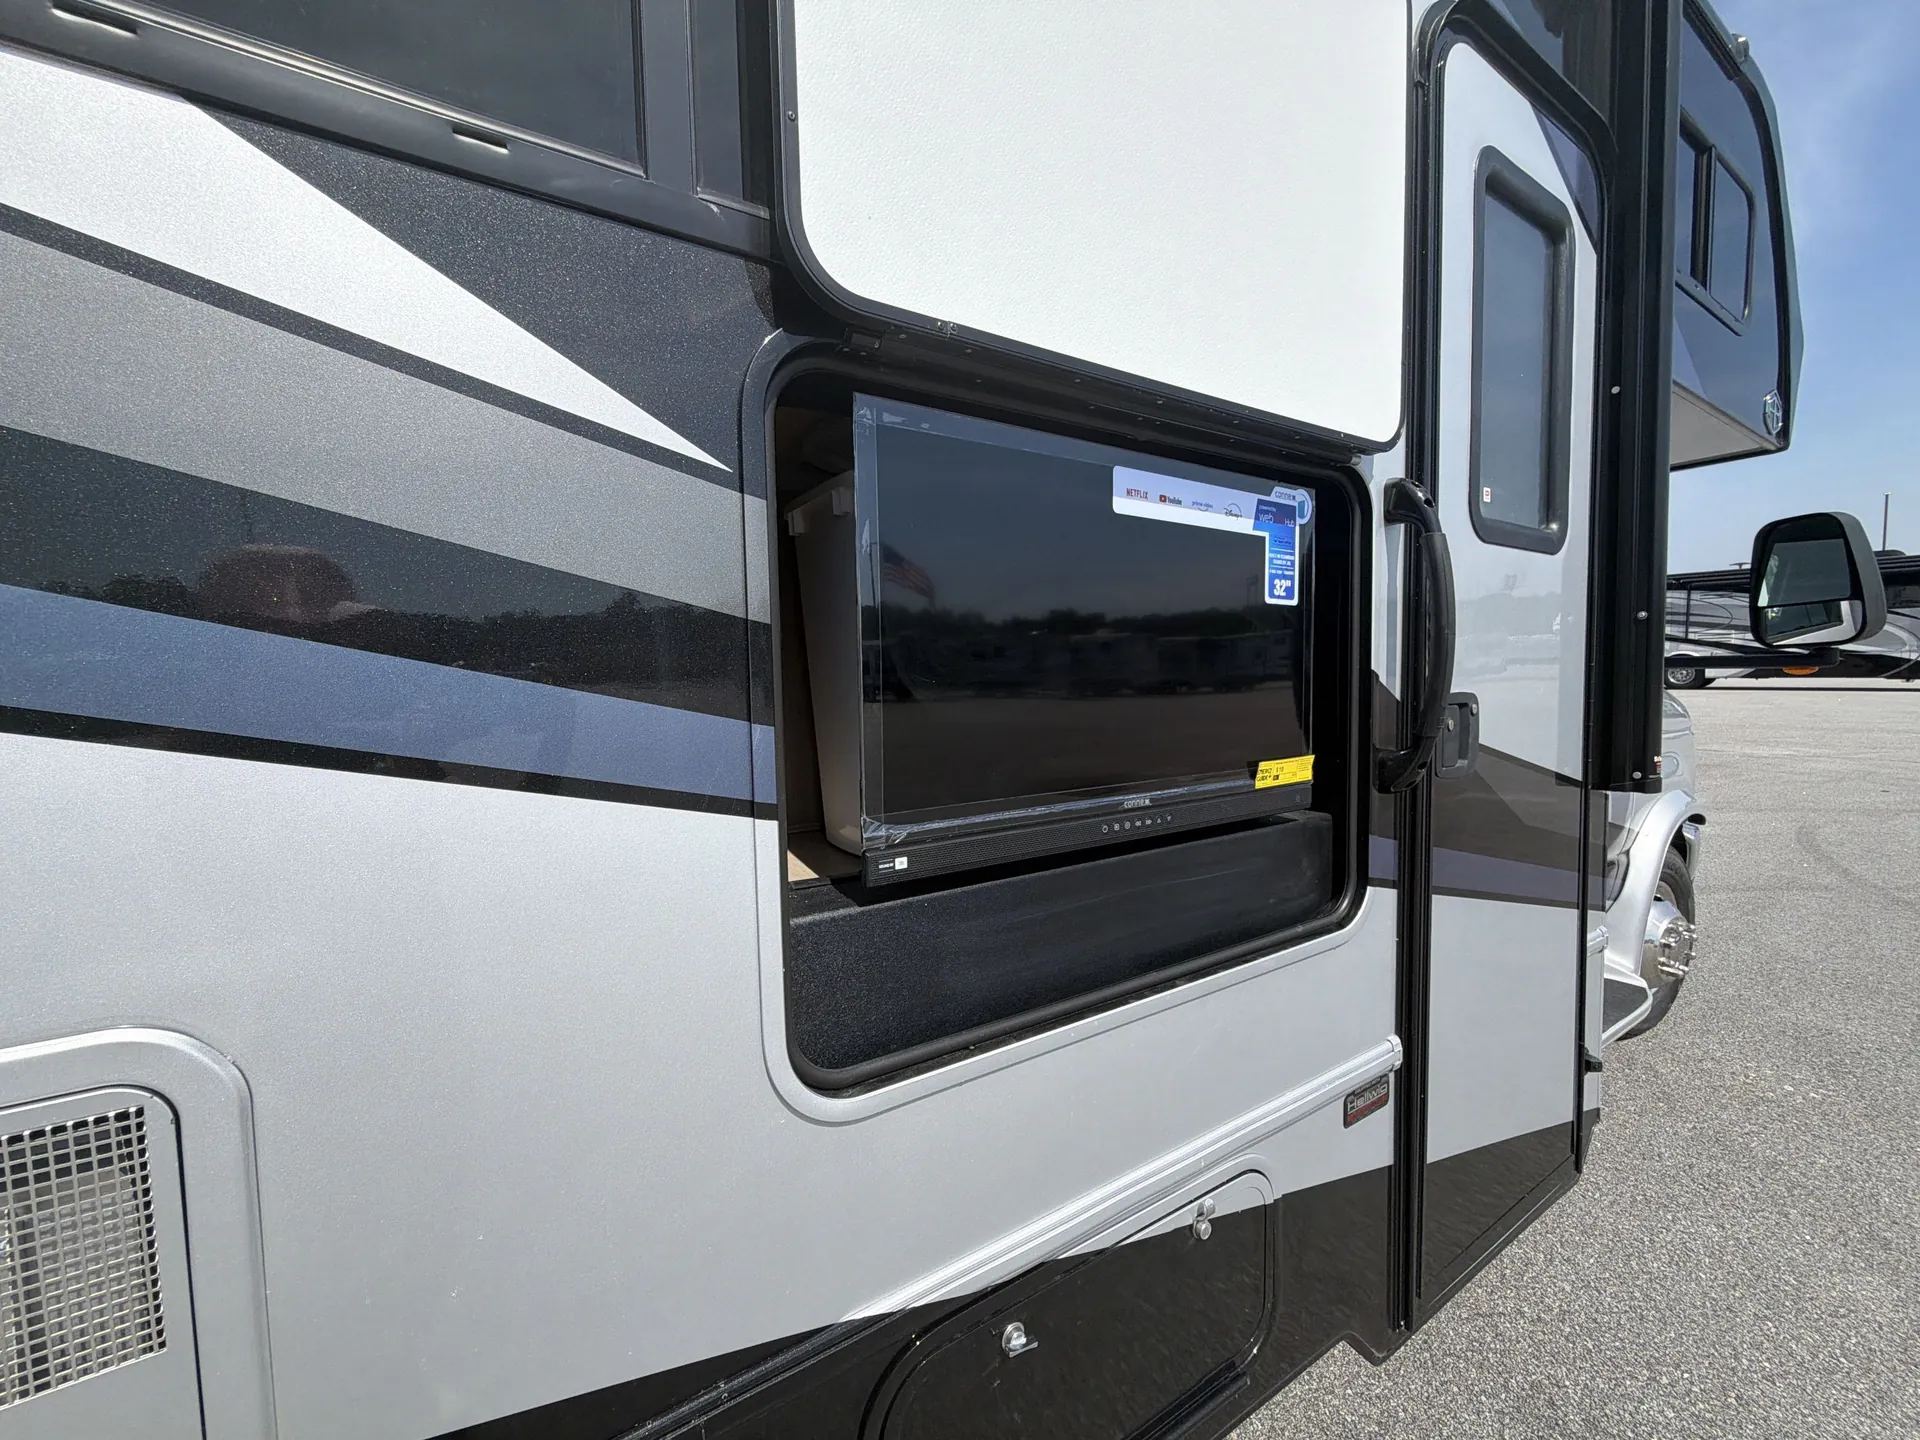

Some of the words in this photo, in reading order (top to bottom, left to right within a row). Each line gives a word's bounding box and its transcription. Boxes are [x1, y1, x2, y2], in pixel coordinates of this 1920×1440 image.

[1126, 487, 1149, 500] NETFLIX
[1167, 496, 1183, 506] YouTube
[1191, 500, 1203, 508] prime
[1273, 578, 1292, 597] 32"
[1347, 1083, 1388, 1113] Hellwig
